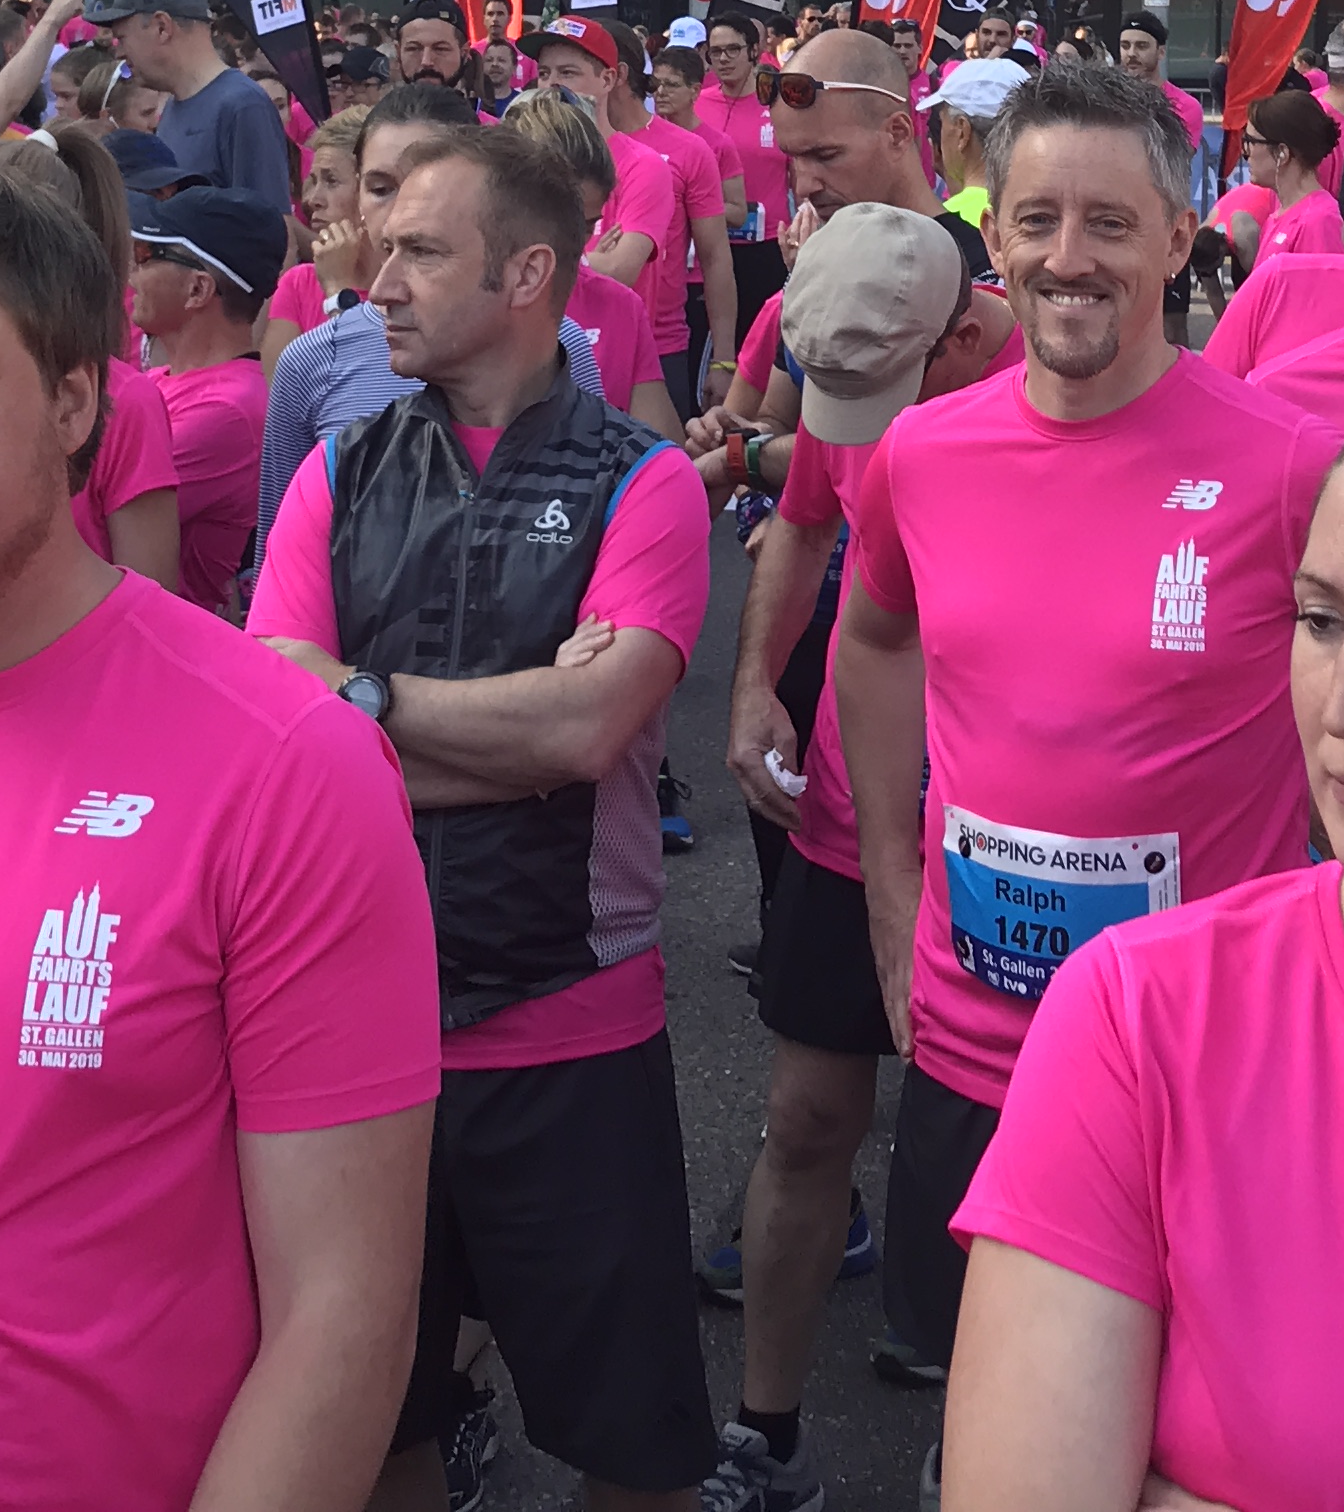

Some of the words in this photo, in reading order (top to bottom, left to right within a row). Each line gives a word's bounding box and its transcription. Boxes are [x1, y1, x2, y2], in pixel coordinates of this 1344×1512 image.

[526, 531, 574, 545] odlo
[1156, 535, 1210, 585] AUF
[1154, 584, 1207, 602] FAHRTS
[1151, 598, 1207, 625] LAUF
[959, 823, 1047, 867] SHOPPING
[1050, 852, 1128, 873] ARENA
[995, 877, 1067, 915] Ralph
[33, 880, 121, 961] AUF
[994, 914, 1071, 957] 1470
[28, 956, 113, 987] FAHRTS
[1000, 955, 1046, 980] Gallen
[22, 981, 111, 1026] LAUF
[20, 1025, 43, 1046] ST.
[44, 1027, 104, 1048] GALLEN
[17, 1049, 39, 1067] 30.
[41, 1050, 66, 1068] MAI
[68, 1051, 102, 1069] 2019
